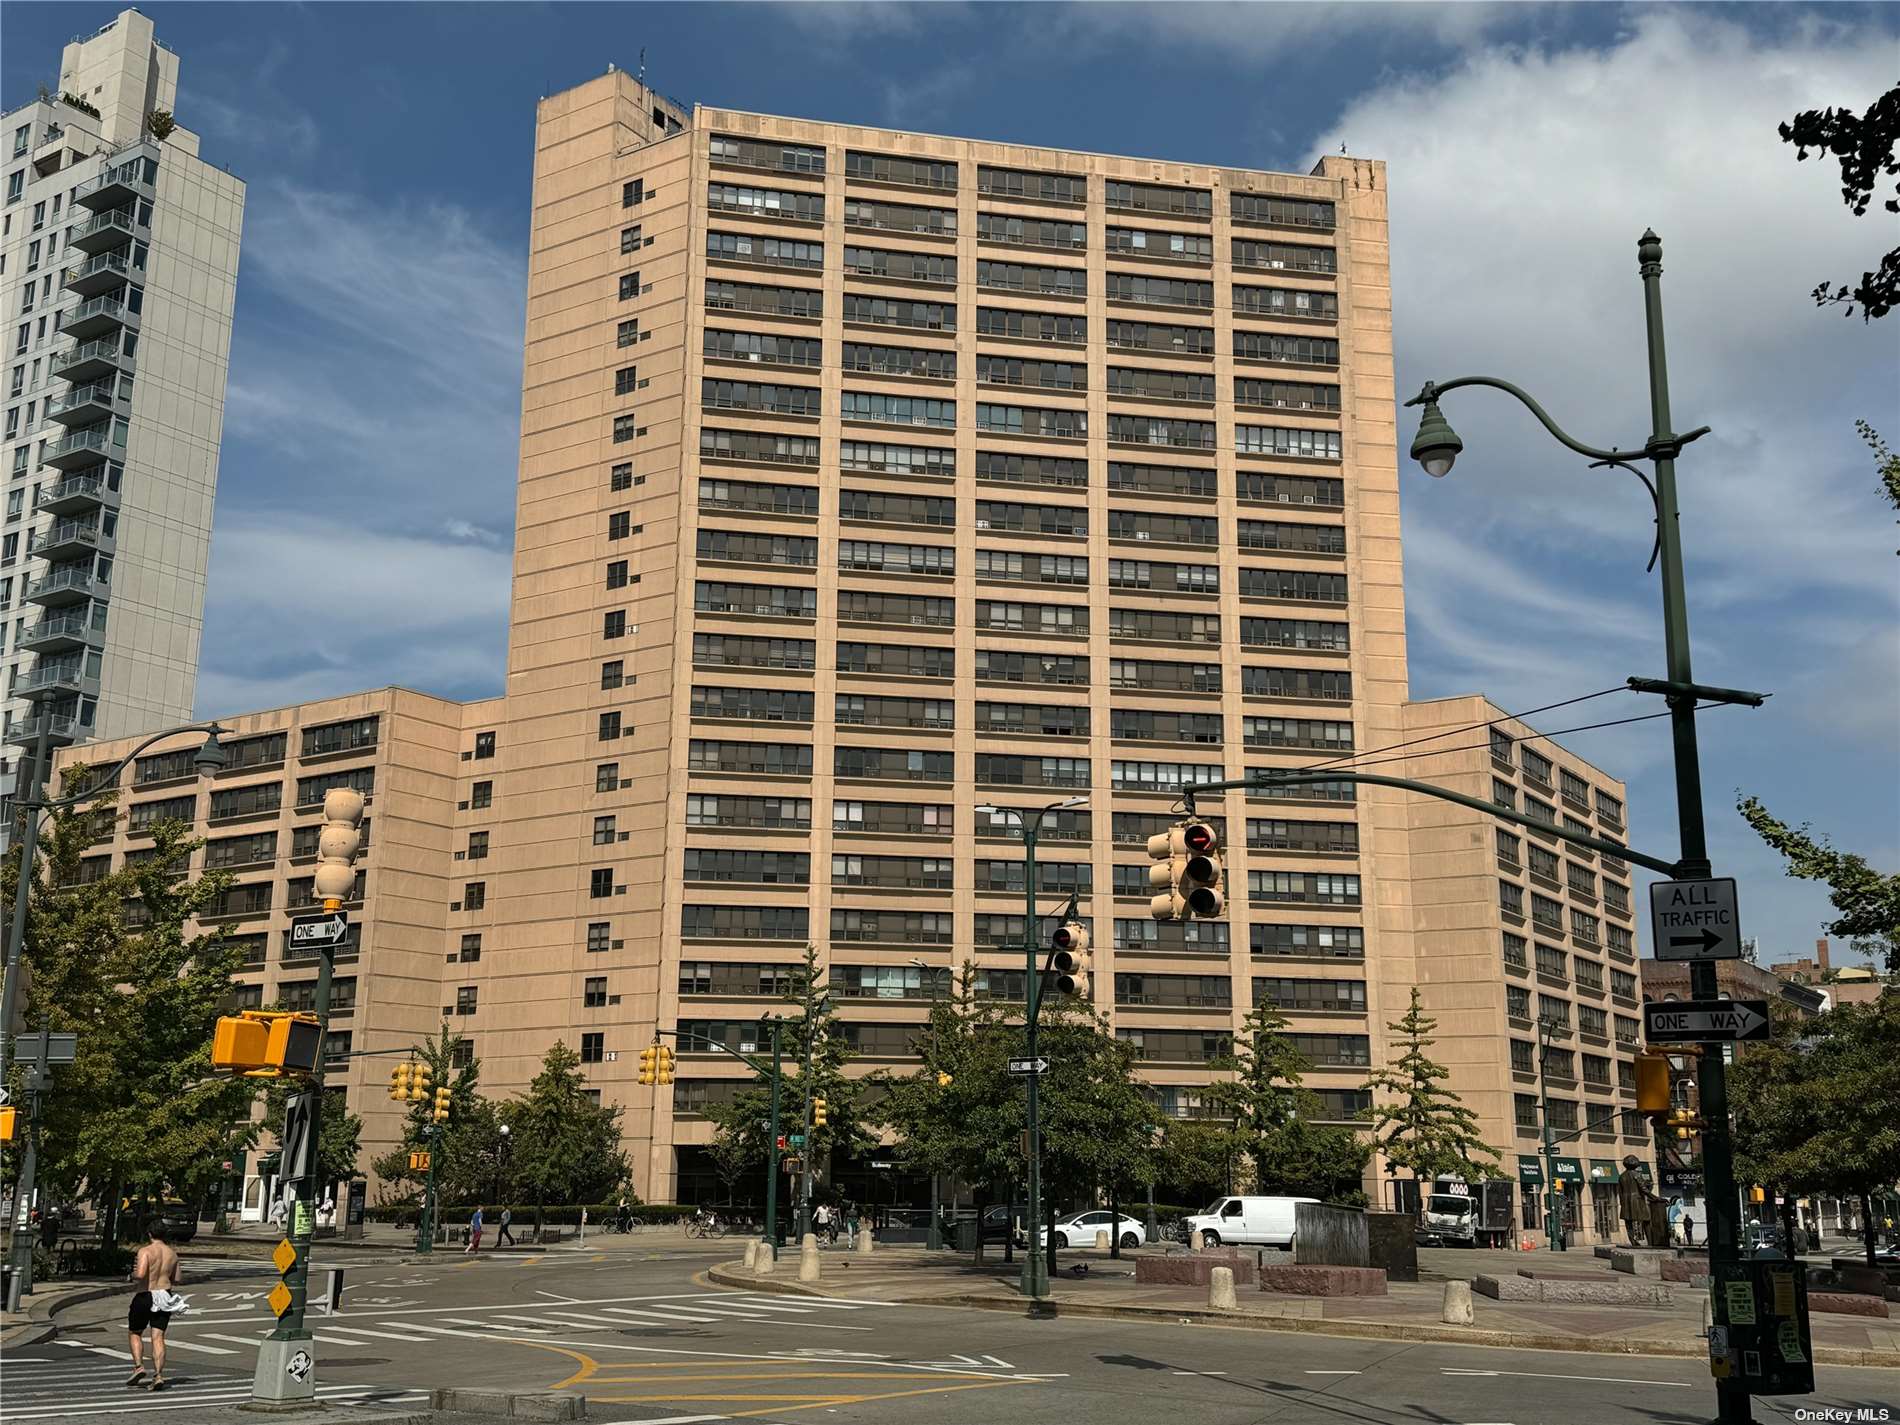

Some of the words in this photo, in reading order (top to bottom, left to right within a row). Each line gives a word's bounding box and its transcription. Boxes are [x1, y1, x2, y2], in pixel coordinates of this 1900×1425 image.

[1672, 887, 1717, 906] ALL
[1660, 909, 1730, 927] TRAFFIC
[296, 925, 315, 938] ONE
[324, 922, 341, 936] WAY
[1654, 1014, 1688, 1030] ONE
[1710, 1013, 1751, 1029] WAY
[1012, 1062, 1024, 1070] ONE
[1030, 1061, 1043, 1069] WAY
